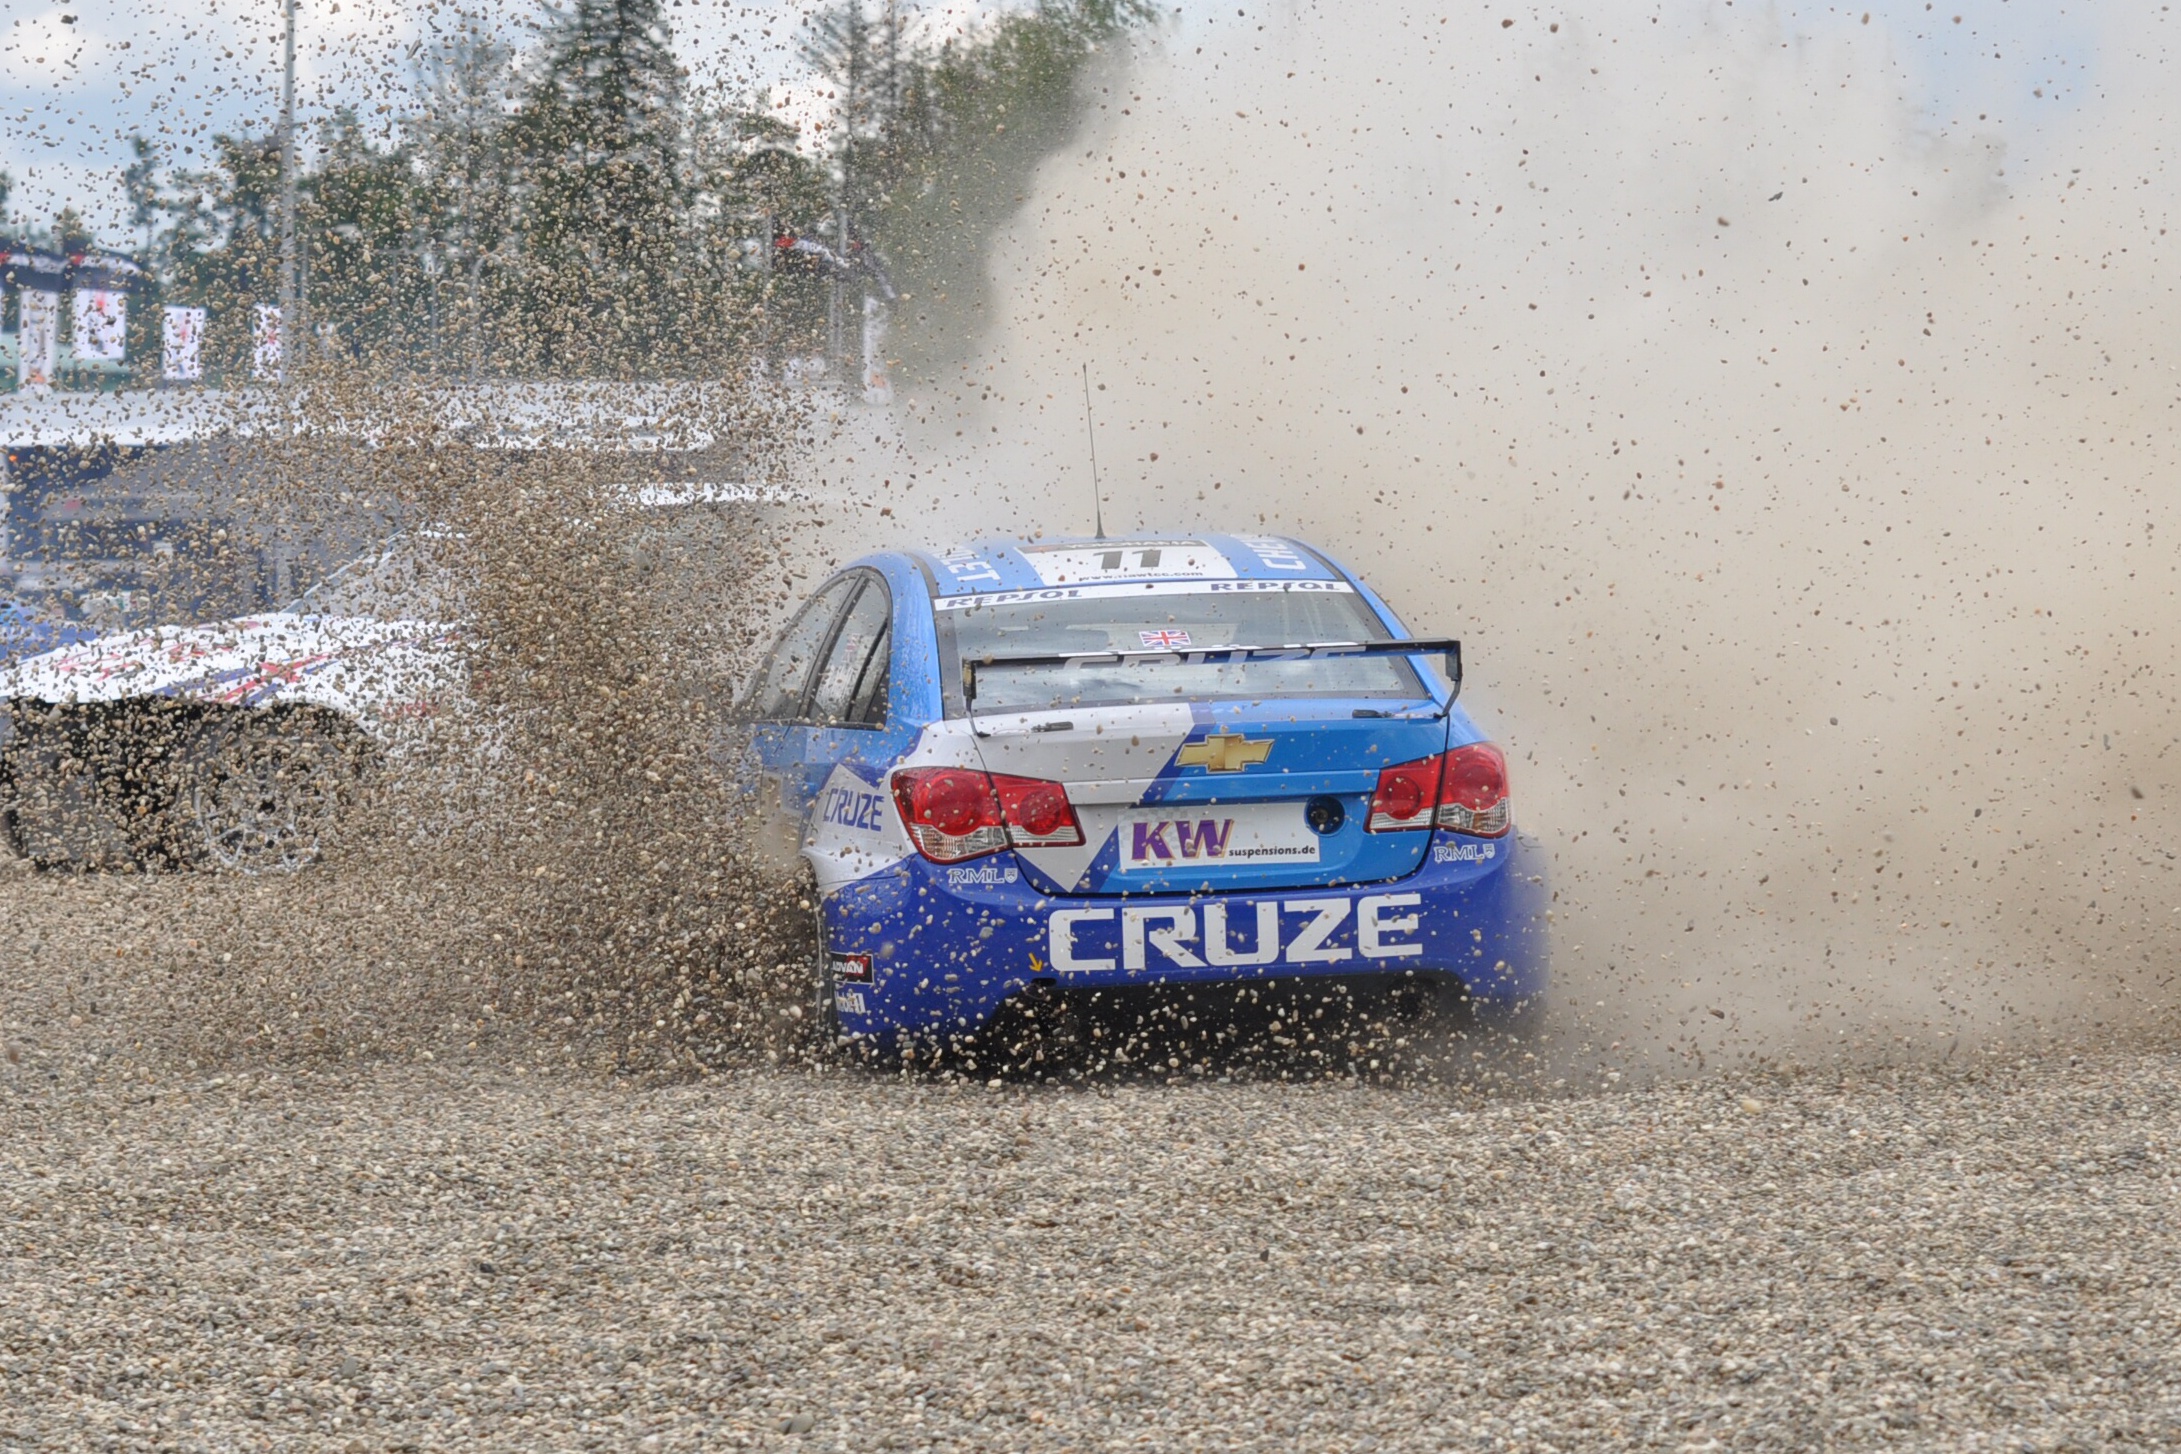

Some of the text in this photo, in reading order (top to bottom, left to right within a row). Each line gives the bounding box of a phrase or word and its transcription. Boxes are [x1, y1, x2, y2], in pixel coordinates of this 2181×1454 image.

[1092, 549, 1162, 570] 11
[1210, 582, 1341, 592] REPSOL
[946, 589, 1083, 608] REPSOL
[822, 787, 885, 832] CRUZE
[1131, 818, 1317, 861] KW suspensions.de
[1433, 844, 1485, 863] RML
[948, 867, 1005, 884] RML
[1048, 893, 1423, 972] CRUZE
